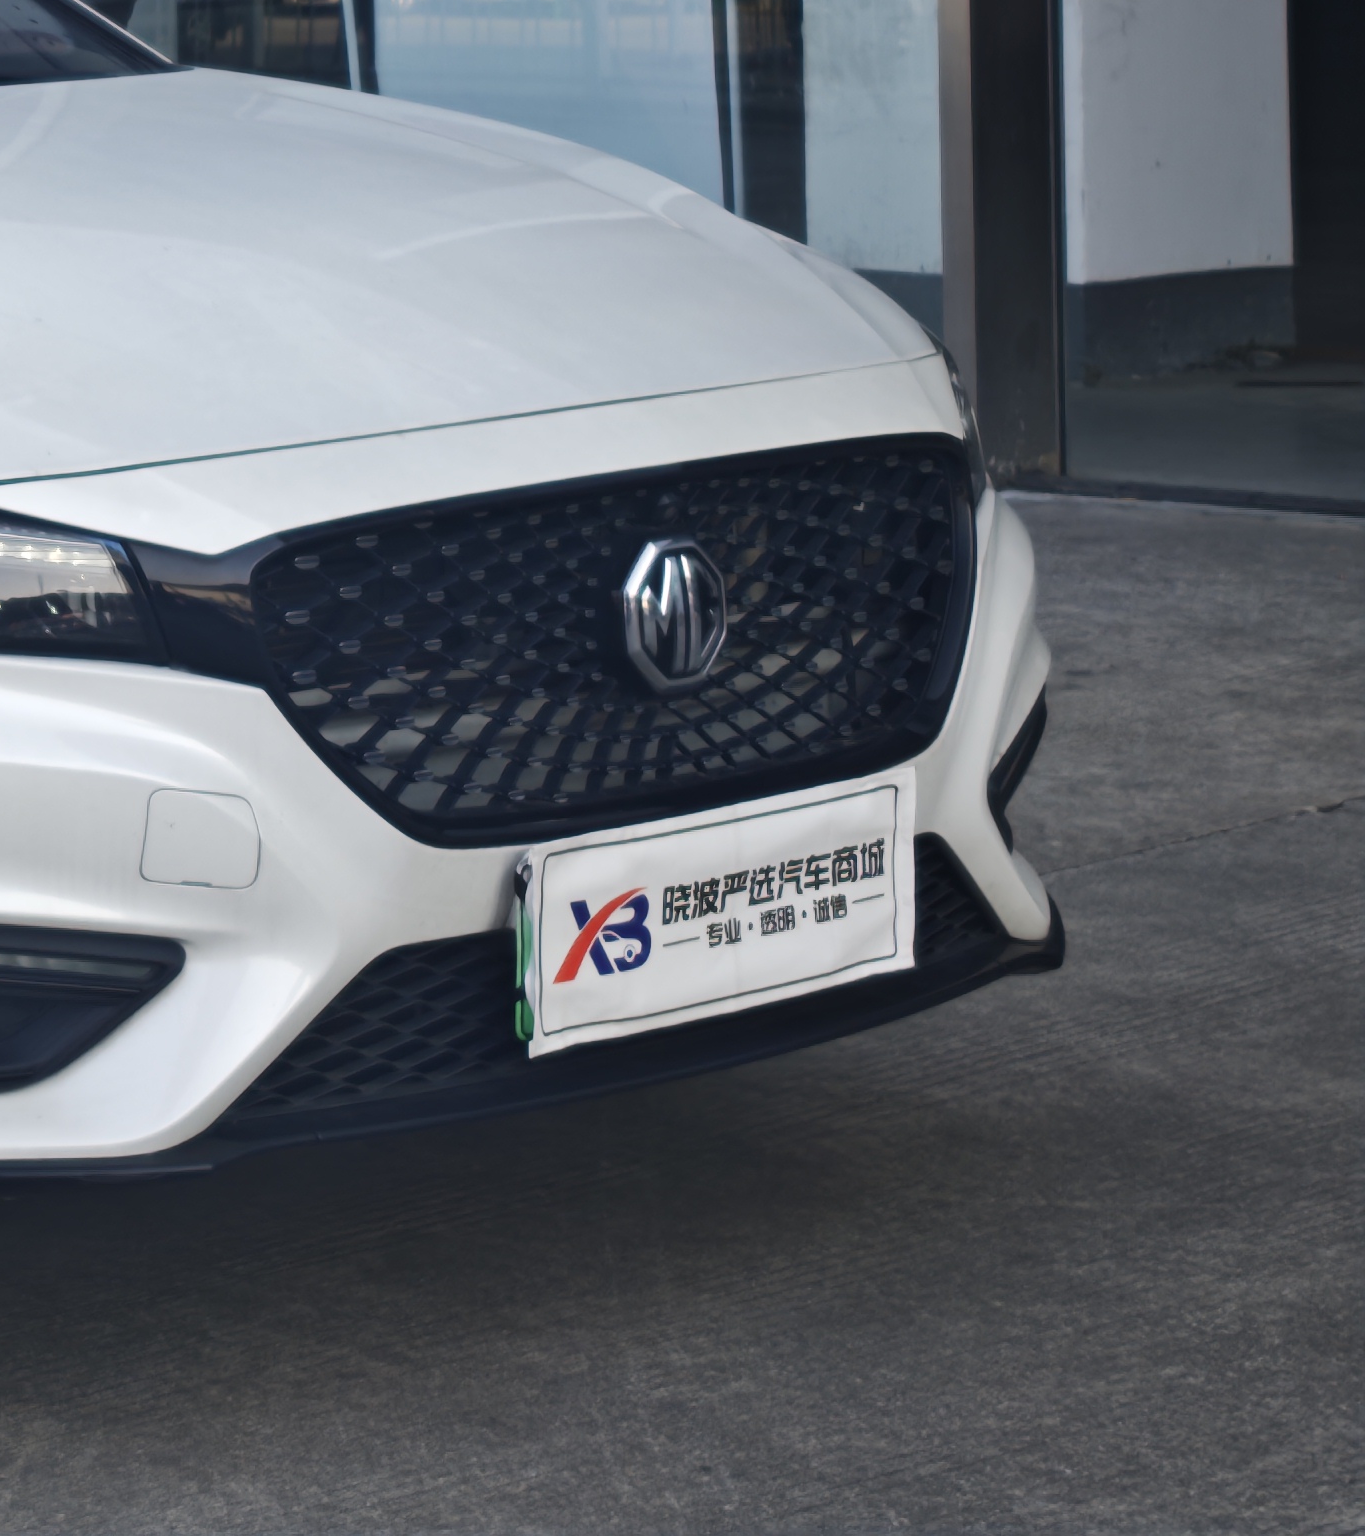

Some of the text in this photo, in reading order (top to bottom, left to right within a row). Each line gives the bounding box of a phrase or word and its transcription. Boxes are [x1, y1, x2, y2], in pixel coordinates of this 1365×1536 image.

[632, 547, 725, 684] MG
[662, 837, 885, 926] 晓波严选汽车商城
